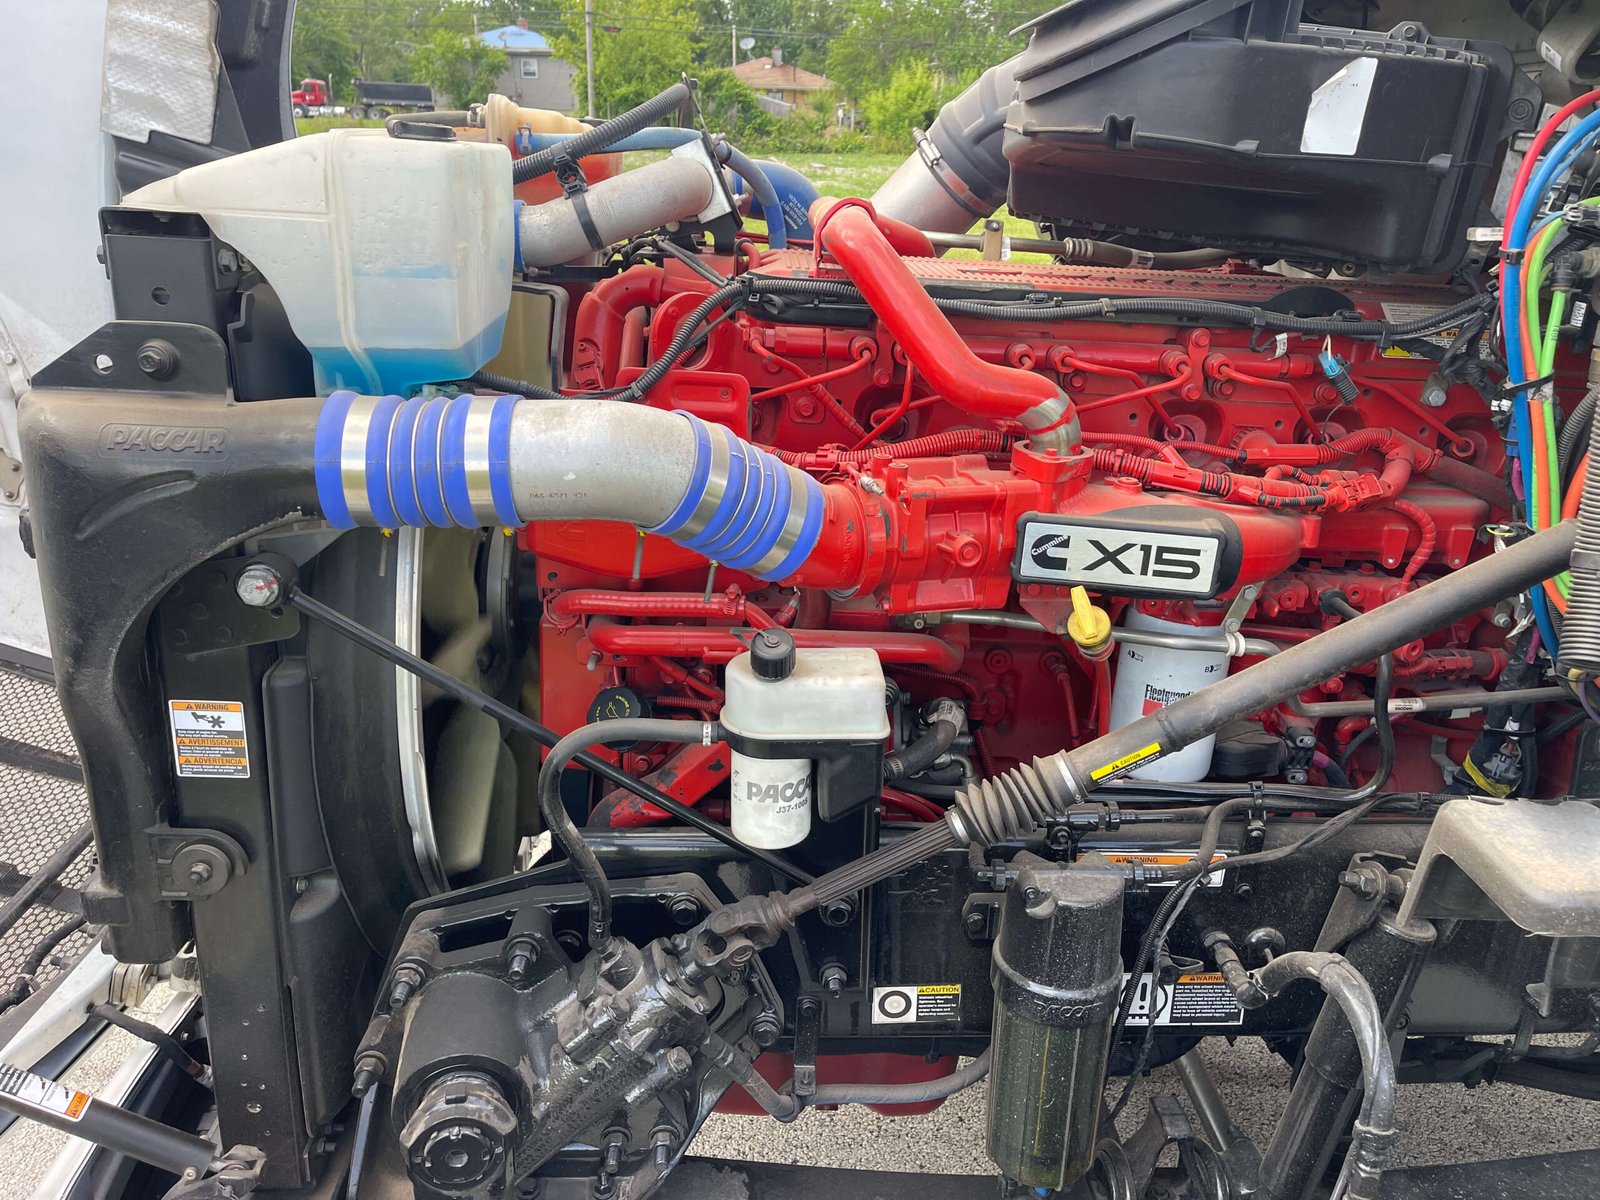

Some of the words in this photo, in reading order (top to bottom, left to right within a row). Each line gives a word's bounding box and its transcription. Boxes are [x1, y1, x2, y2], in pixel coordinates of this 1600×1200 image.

[106, 427, 227, 454] PACCAR
[1031, 534, 1069, 556] Cummins
[1081, 539, 1201, 580] X15
[194, 703, 229, 711] WARNING
[188, 738, 243, 747] AVERTISSEMENT
[193, 757, 243, 765] ADVERTENCIA
[1120, 753, 1141, 766] CAUTION
